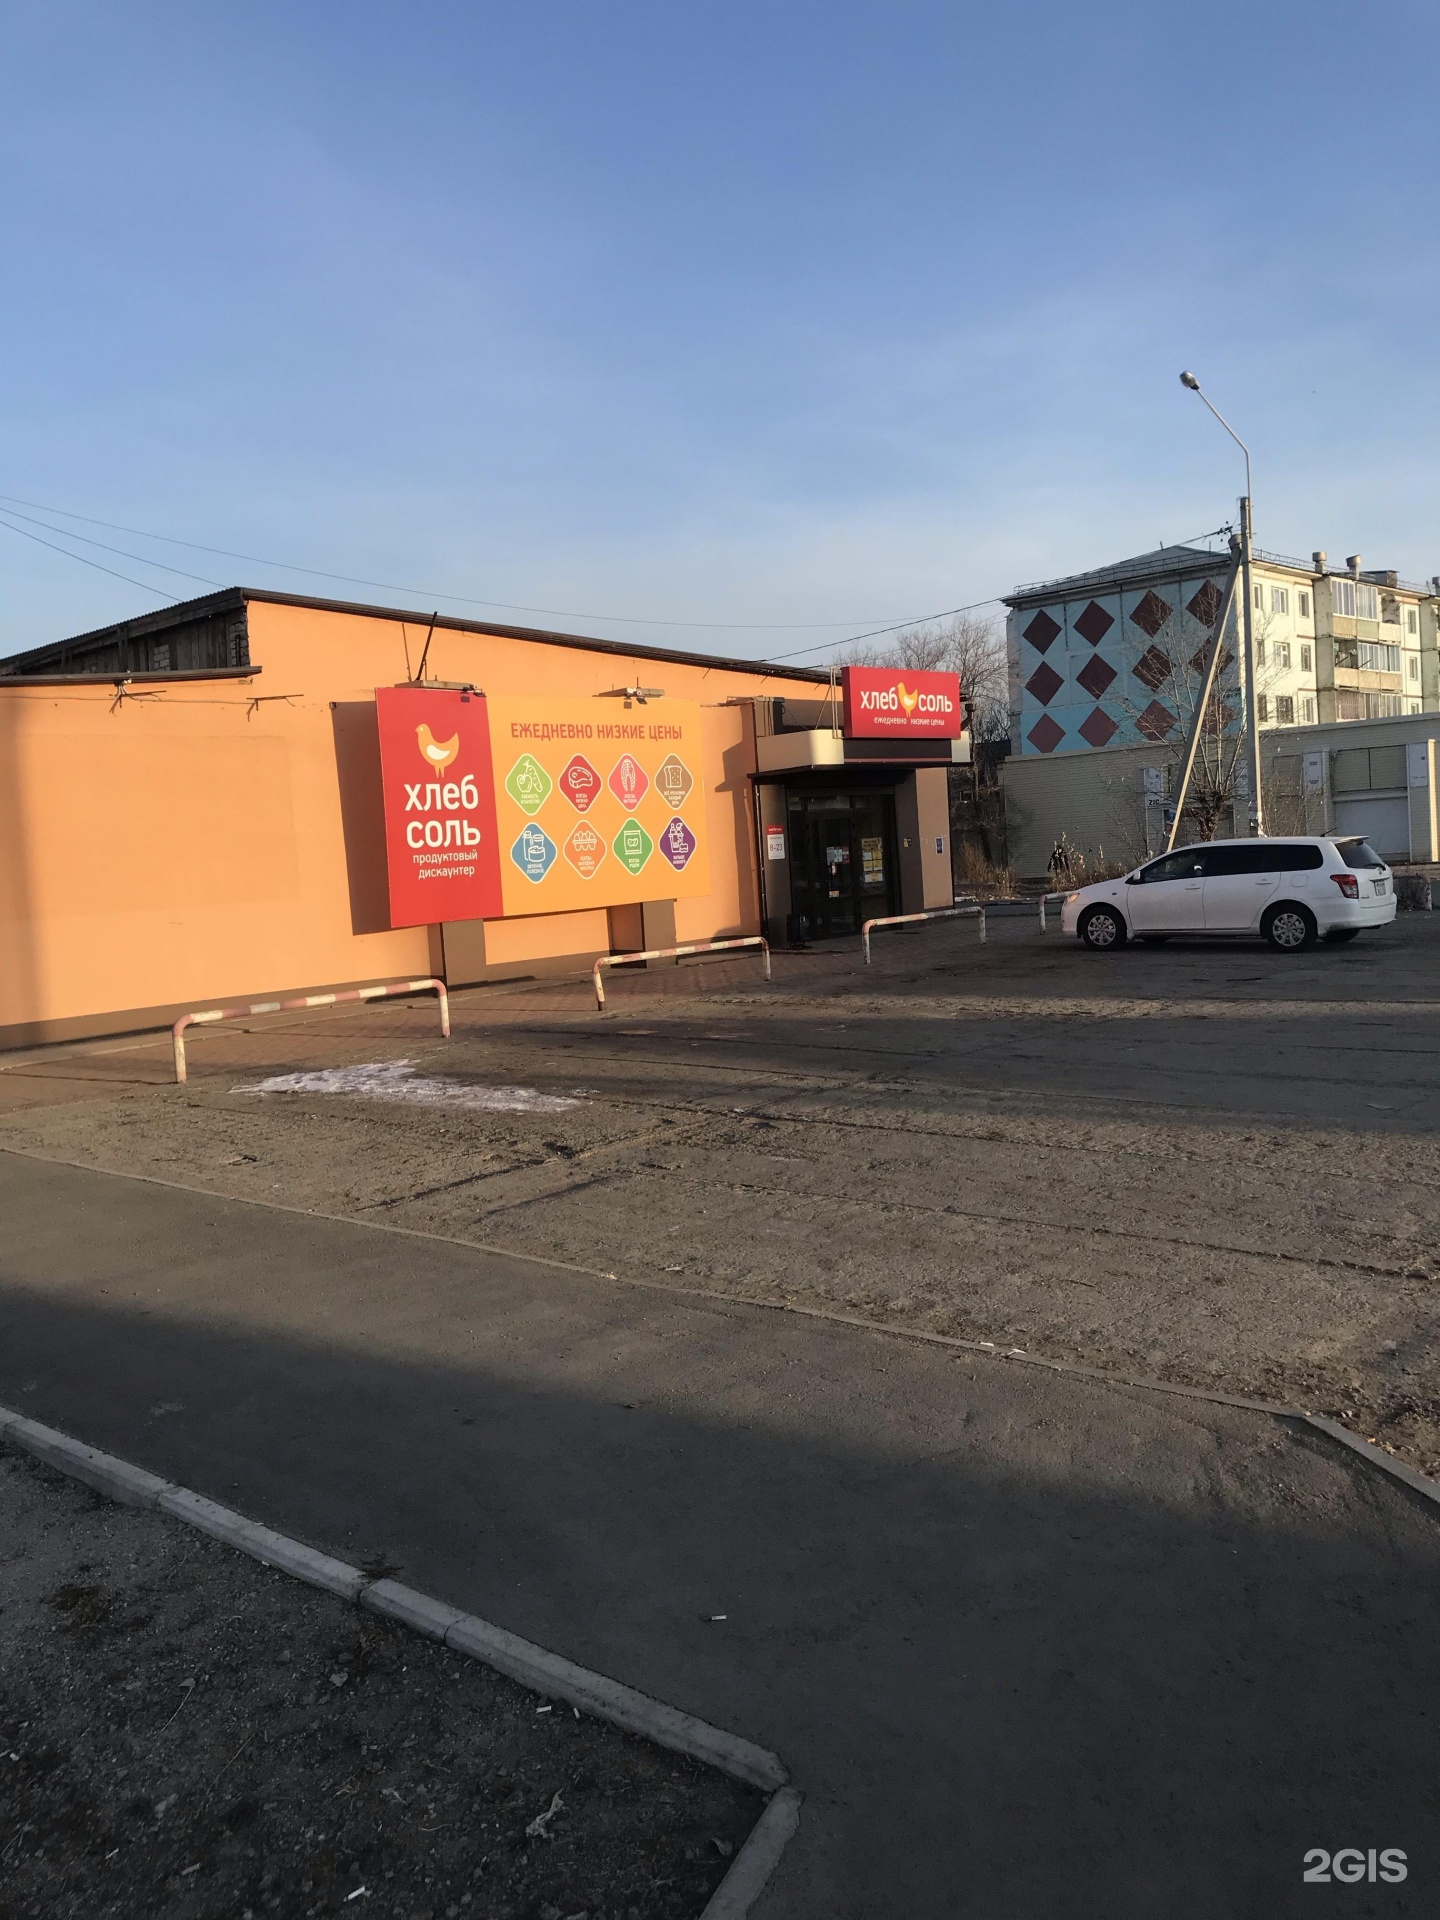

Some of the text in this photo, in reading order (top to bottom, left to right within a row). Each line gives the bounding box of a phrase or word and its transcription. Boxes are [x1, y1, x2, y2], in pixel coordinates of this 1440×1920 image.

[860, 686, 898, 711] хлеб
[918, 694, 953, 713] соль
[873, 716, 945, 727] ежедневно низкие цены
[510, 722, 682, 743] ЕЖЕДНЕВНО НИЗКИЕ ЦЕНЫ
[403, 774, 479, 812] хлеб
[406, 819, 481, 849] соль
[413, 849, 478, 867] продуктовый
[418, 865, 475, 880] дискаунтер
